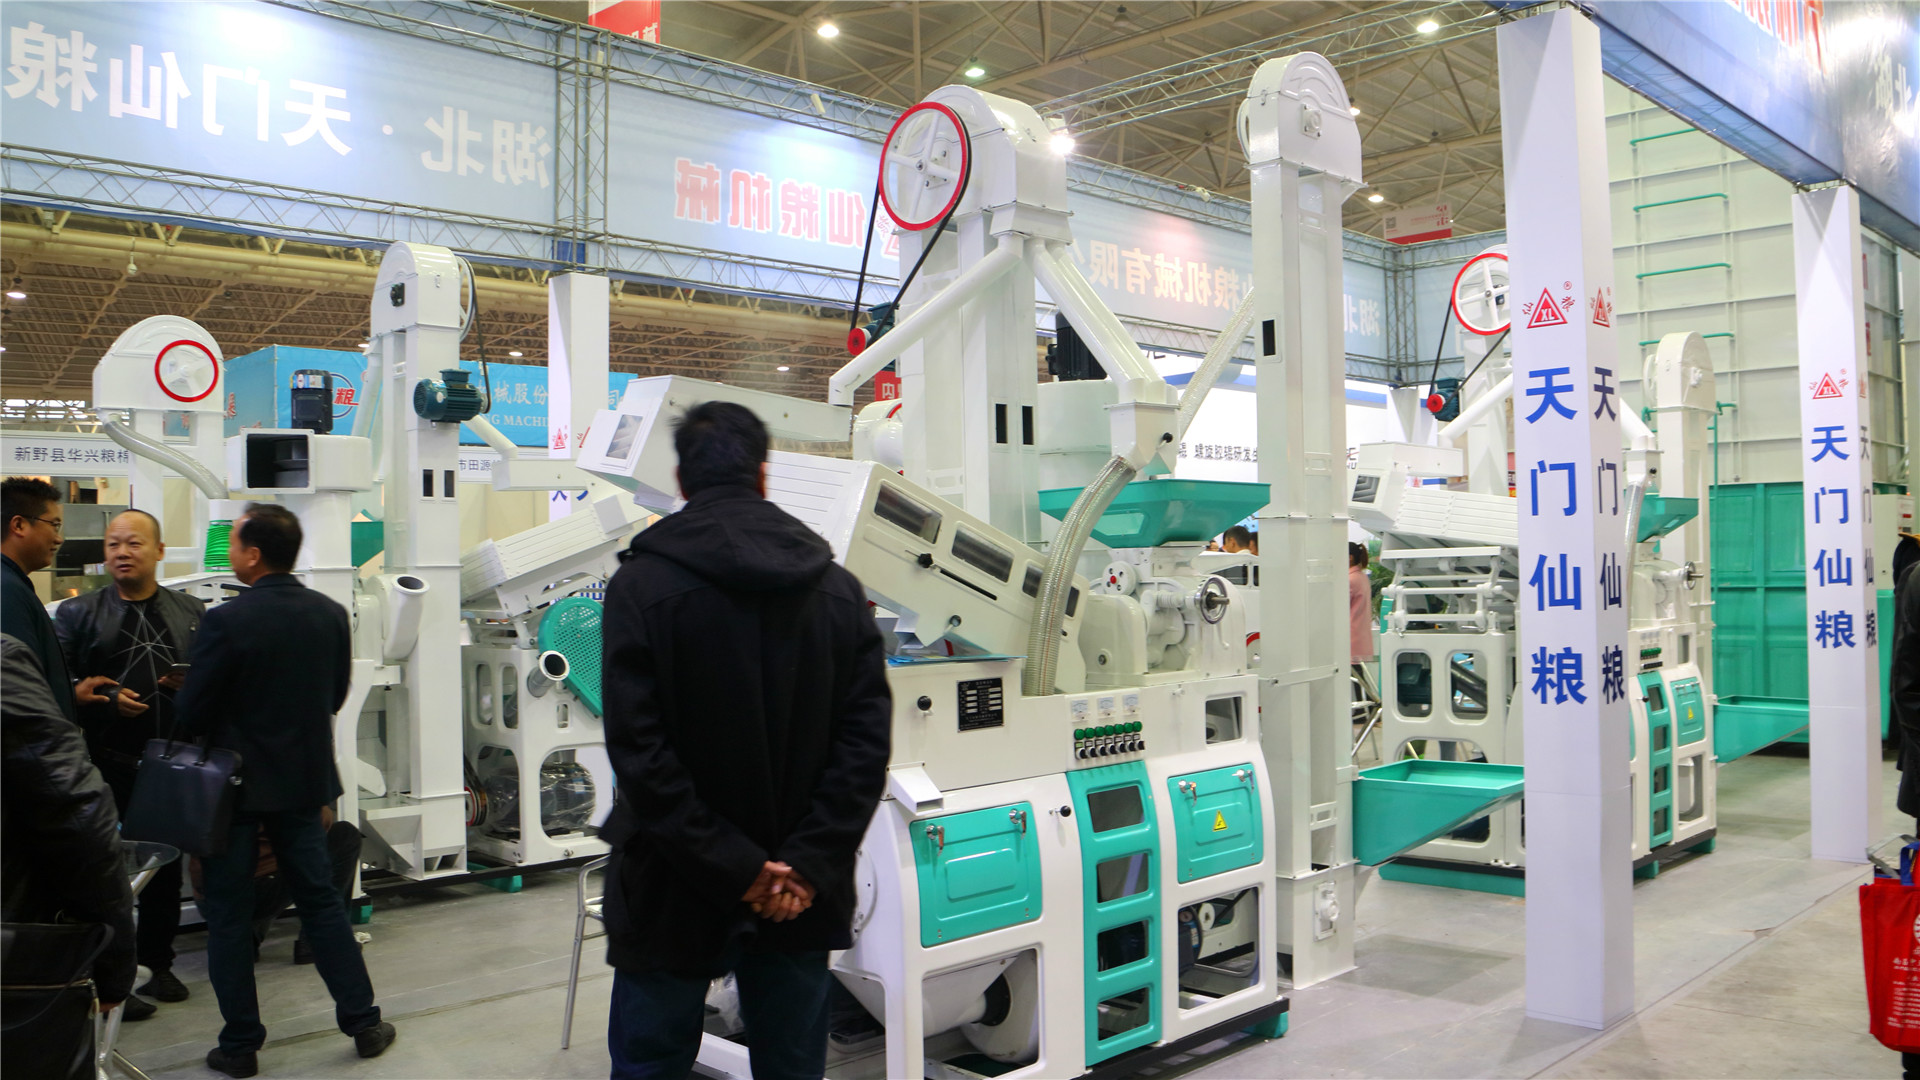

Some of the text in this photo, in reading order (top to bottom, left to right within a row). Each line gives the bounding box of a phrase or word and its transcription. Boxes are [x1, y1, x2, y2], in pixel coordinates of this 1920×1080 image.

[1541, 308, 1555, 322] XL
[882, 383, 902, 399] 内
[504, 415, 548, 427] MACHI
[458, 457, 500, 471] 市田源
[1525, 367, 1588, 705] 天门仙粮
[1594, 367, 1625, 705] 天门仙粮
[1810, 426, 1857, 648] 天门仙粮
